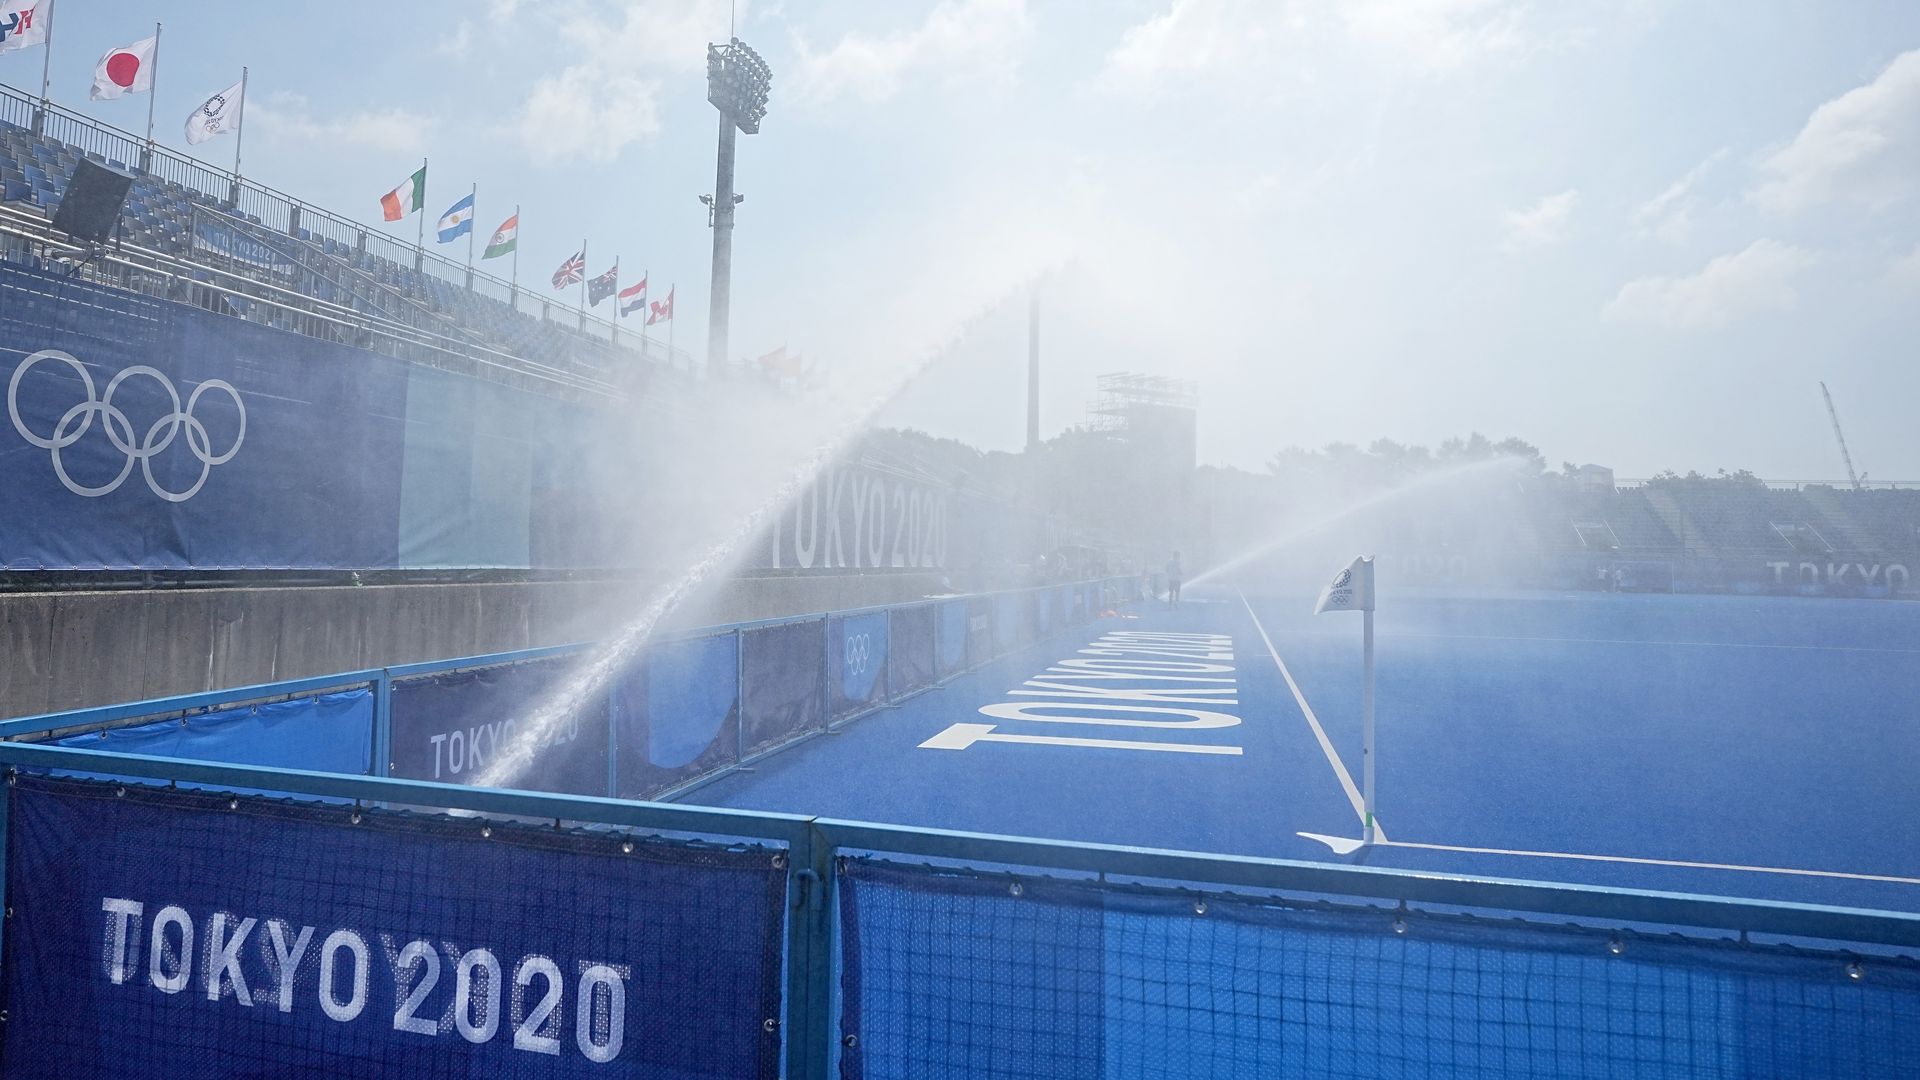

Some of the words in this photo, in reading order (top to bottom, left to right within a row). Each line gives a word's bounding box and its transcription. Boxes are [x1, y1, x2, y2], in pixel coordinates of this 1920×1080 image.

[892, 481, 947, 567] 2020
[1766, 561, 1910, 588] TOKYO
[1077, 631, 1234, 660] 2020
[917, 659, 1243, 755] TOKYO
[102, 897, 367, 1022] TOKYO
[393, 940, 625, 1063] 2020
